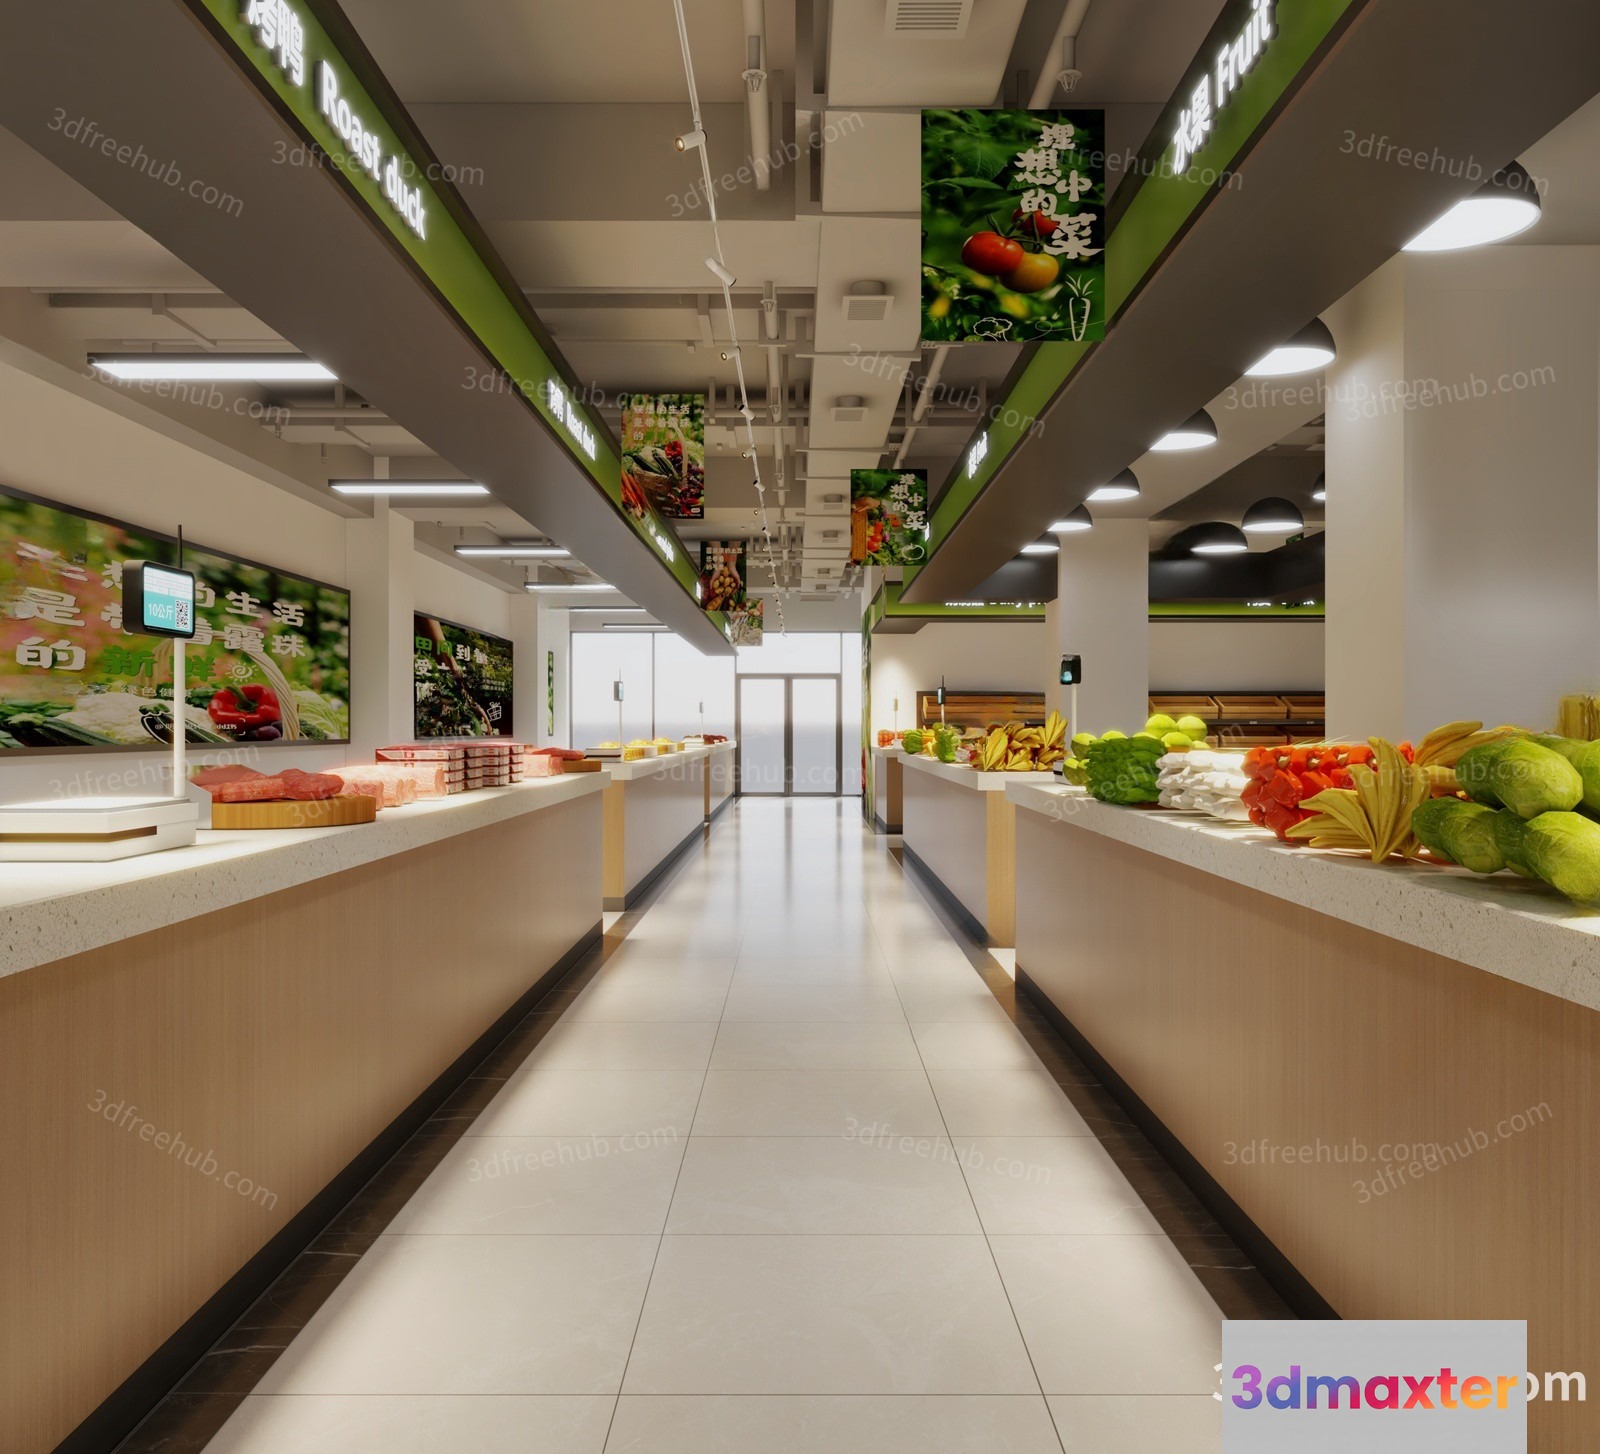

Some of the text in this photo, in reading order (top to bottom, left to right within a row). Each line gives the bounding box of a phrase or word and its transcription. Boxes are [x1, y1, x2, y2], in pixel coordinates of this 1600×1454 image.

[322, 60, 381, 181] Roast
[386, 155, 426, 240] duck
[1173, 0, 1271, 174] 水果 Fruit
[148, 602, 174, 621] 10公斤
